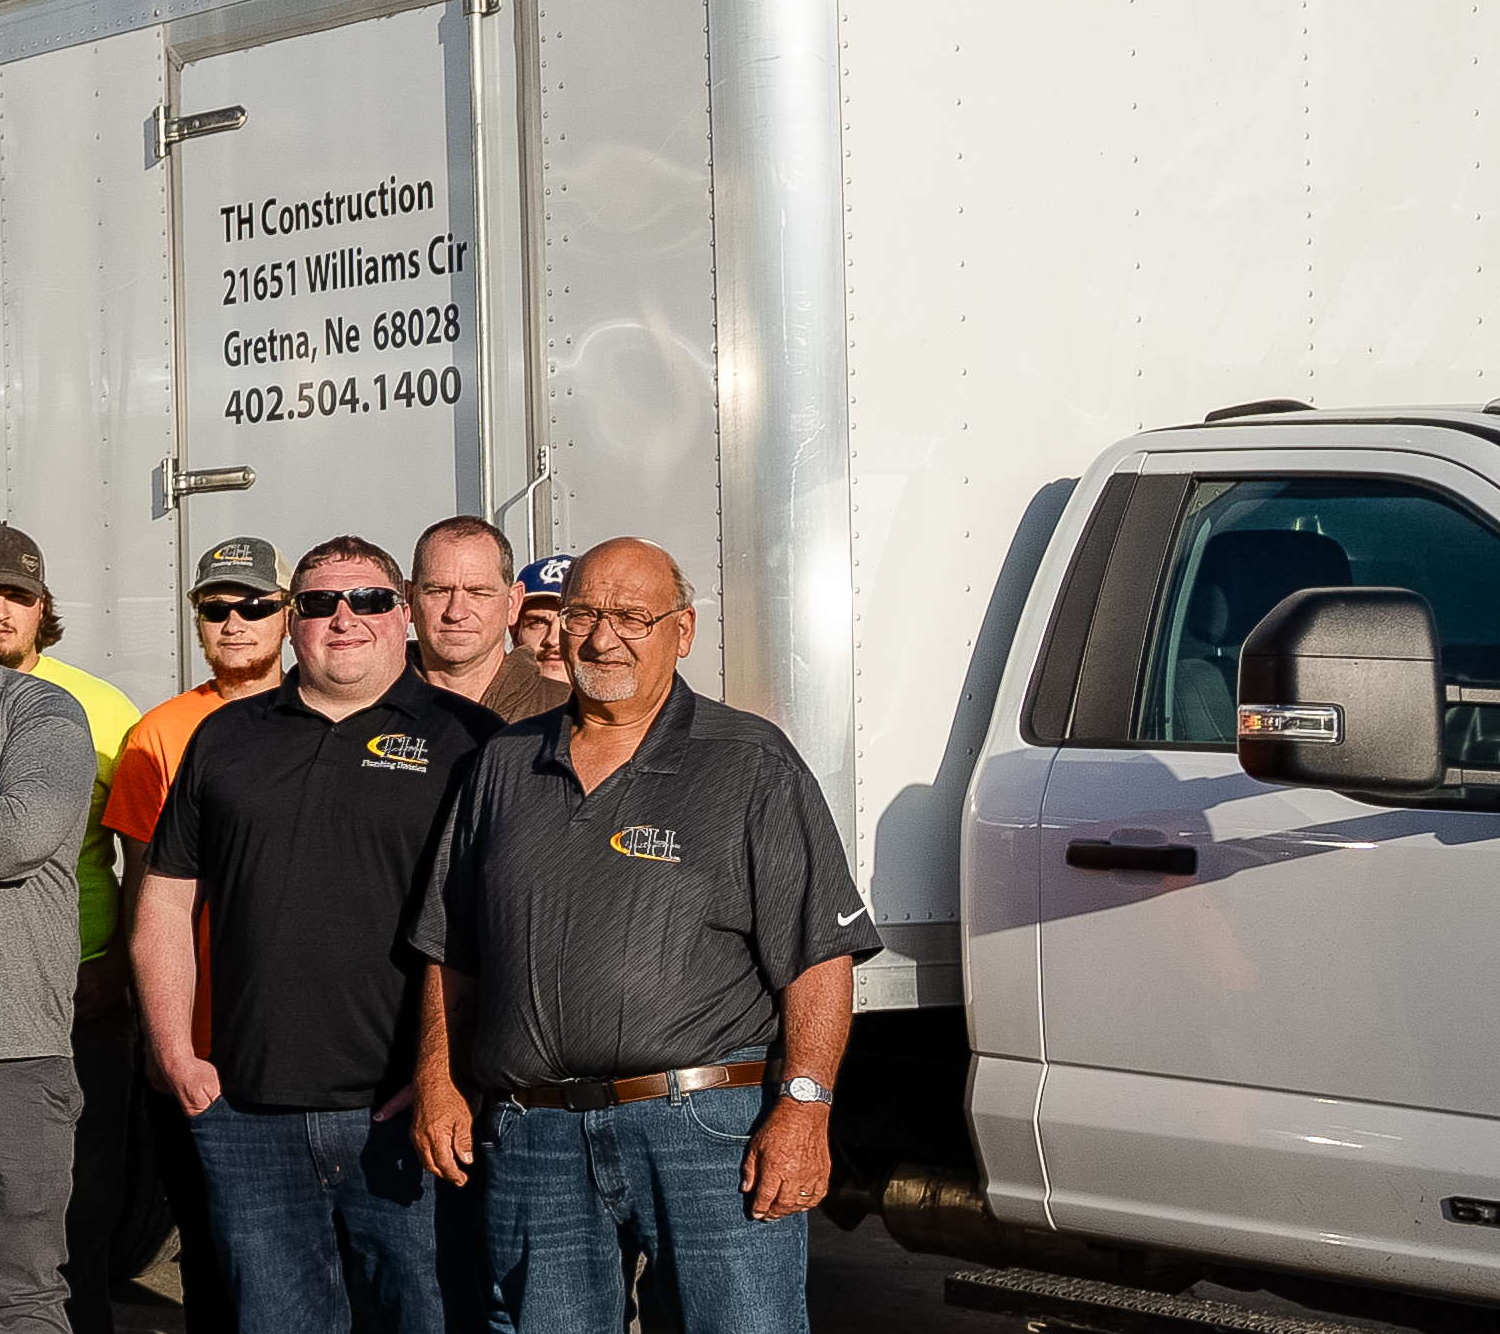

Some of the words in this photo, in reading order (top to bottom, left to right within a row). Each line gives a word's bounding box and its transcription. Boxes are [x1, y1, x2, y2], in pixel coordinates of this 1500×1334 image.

[220, 202, 254, 243] TH
[261, 175, 434, 236] Construction
[223, 259, 297, 306] 21651
[305, 246, 420, 294] Williams
[427, 232, 468, 275] Cir
[224, 328, 317, 367] Gretna,
[325, 317, 360, 356] Ne
[373, 303, 461, 351] 68028
[224, 366, 462, 425] 402.504.1400
[624, 826, 681, 861] TH
